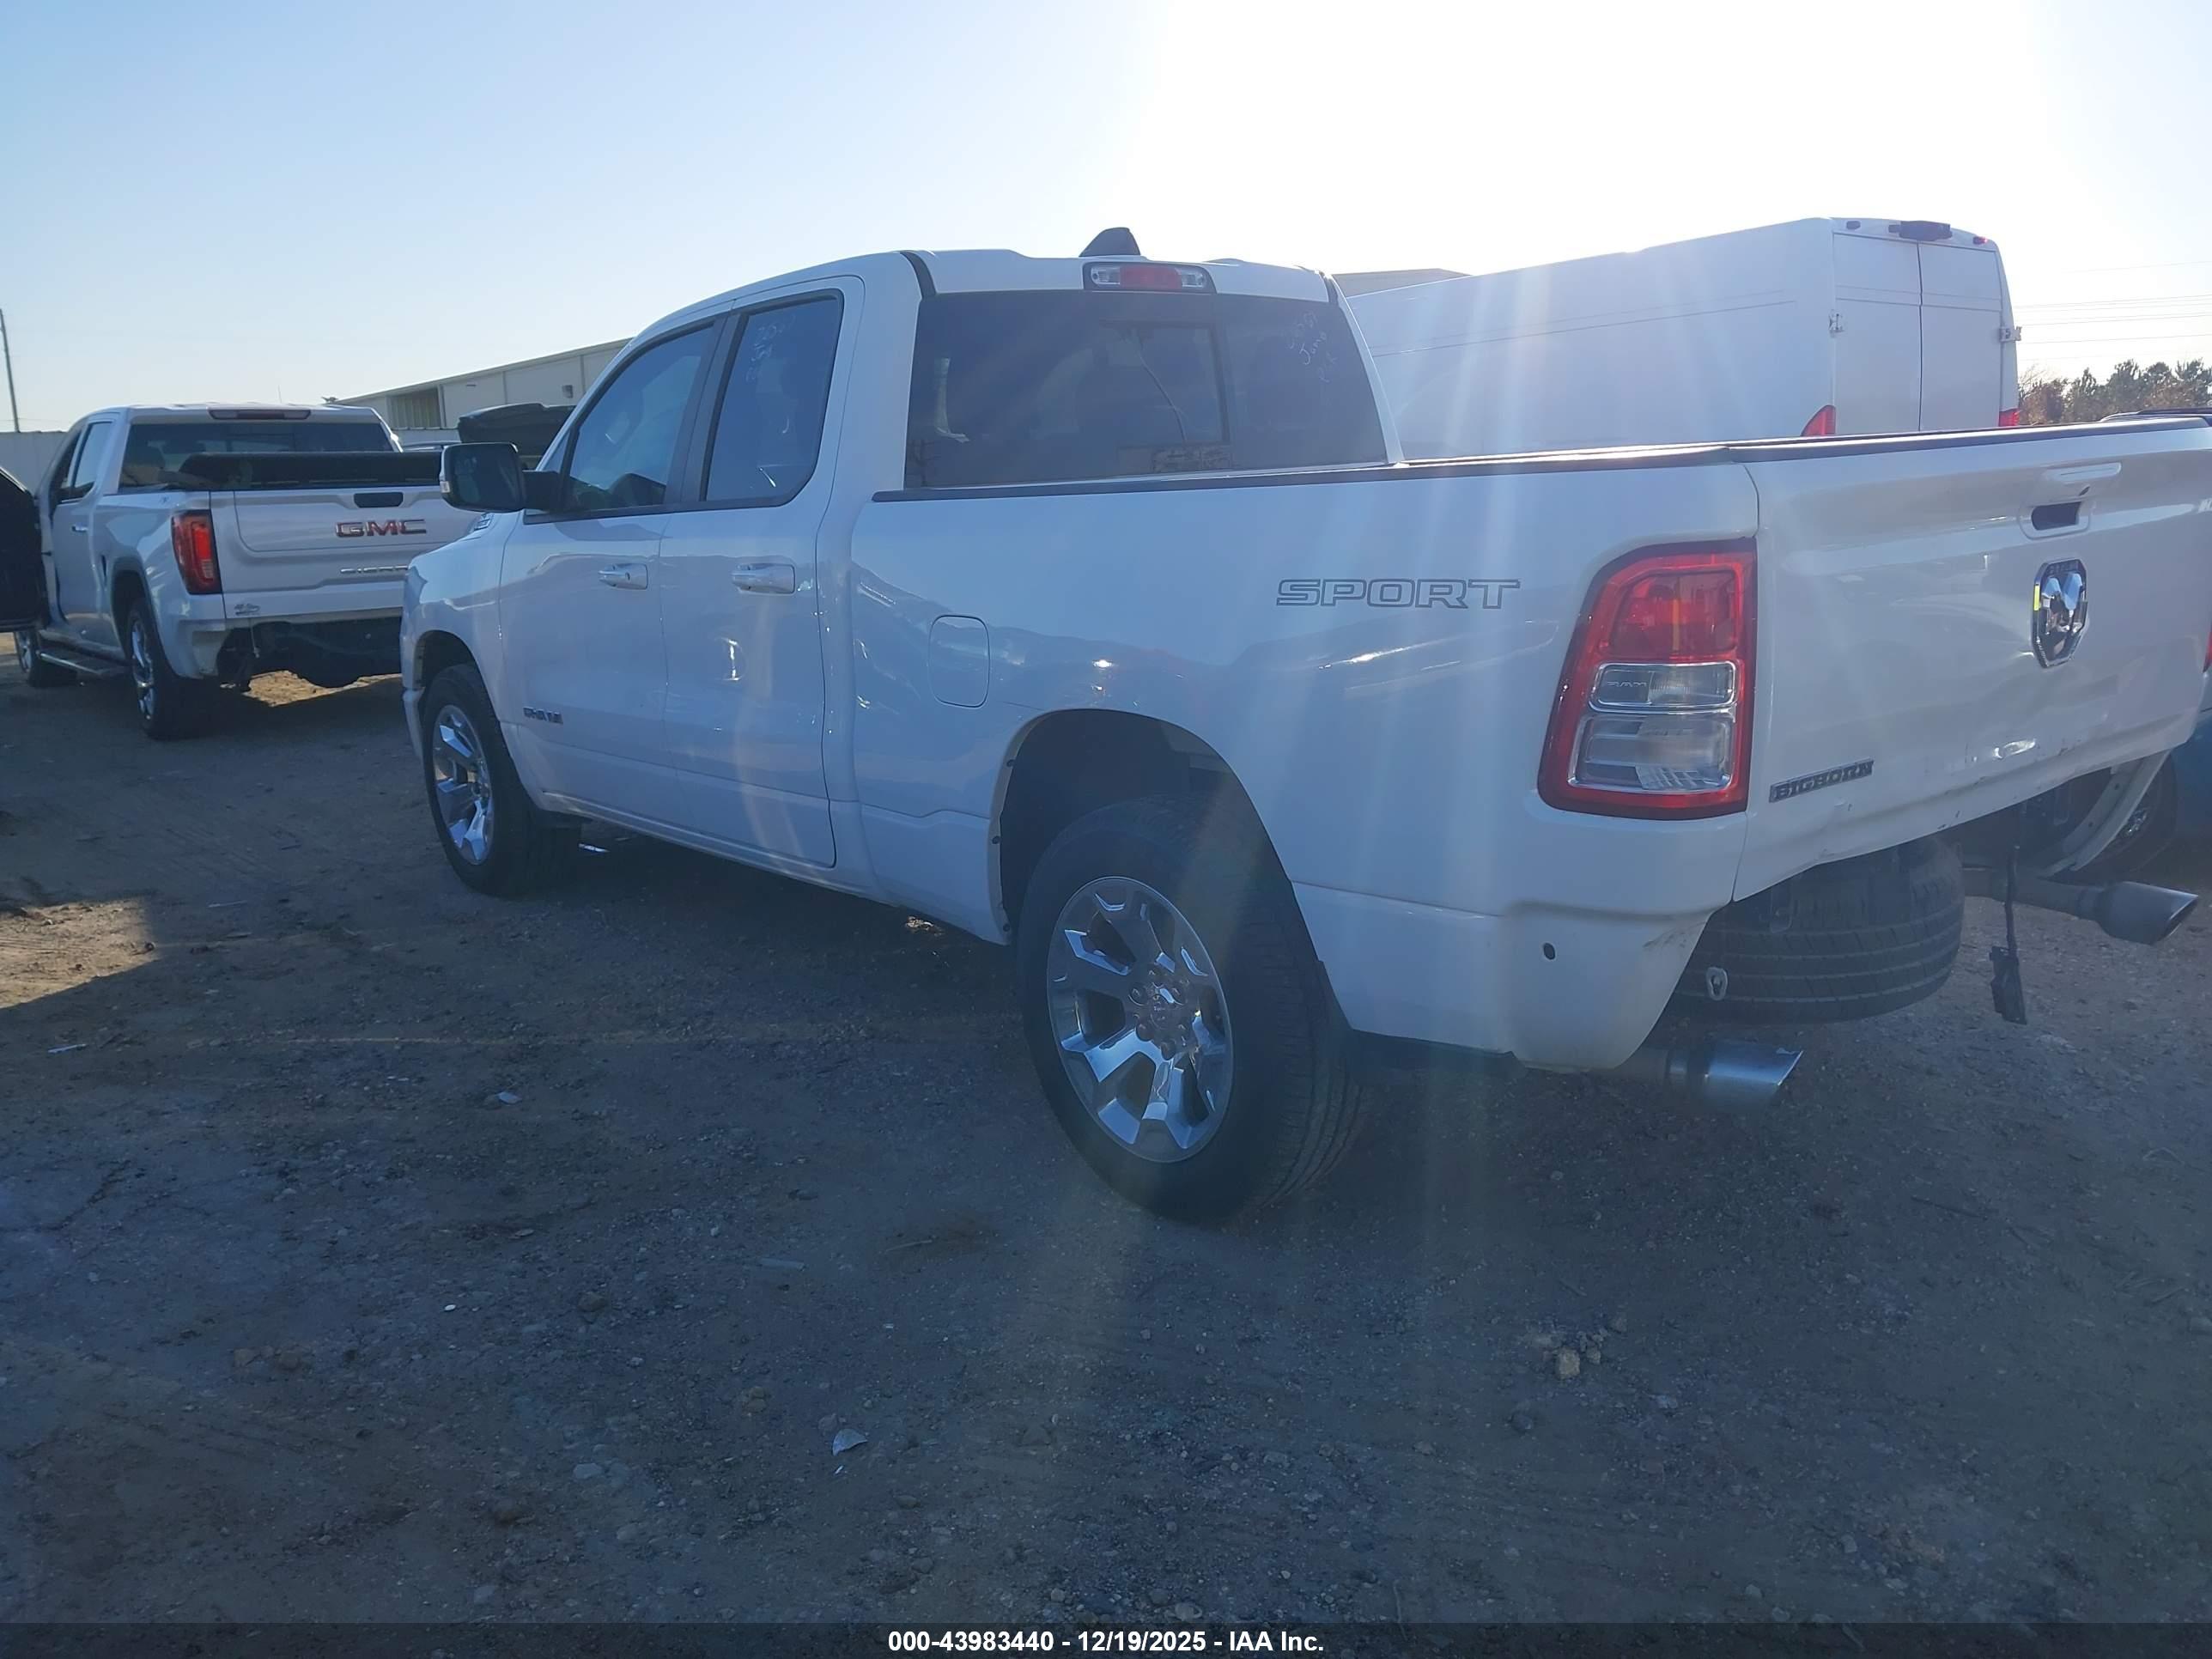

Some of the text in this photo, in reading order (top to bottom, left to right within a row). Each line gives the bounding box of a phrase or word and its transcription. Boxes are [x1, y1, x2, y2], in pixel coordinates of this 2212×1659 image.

[335, 518, 428, 538] GMC
[1276, 578, 1521, 610] SPORT
[1768, 757, 1875, 804] BIGHORN
